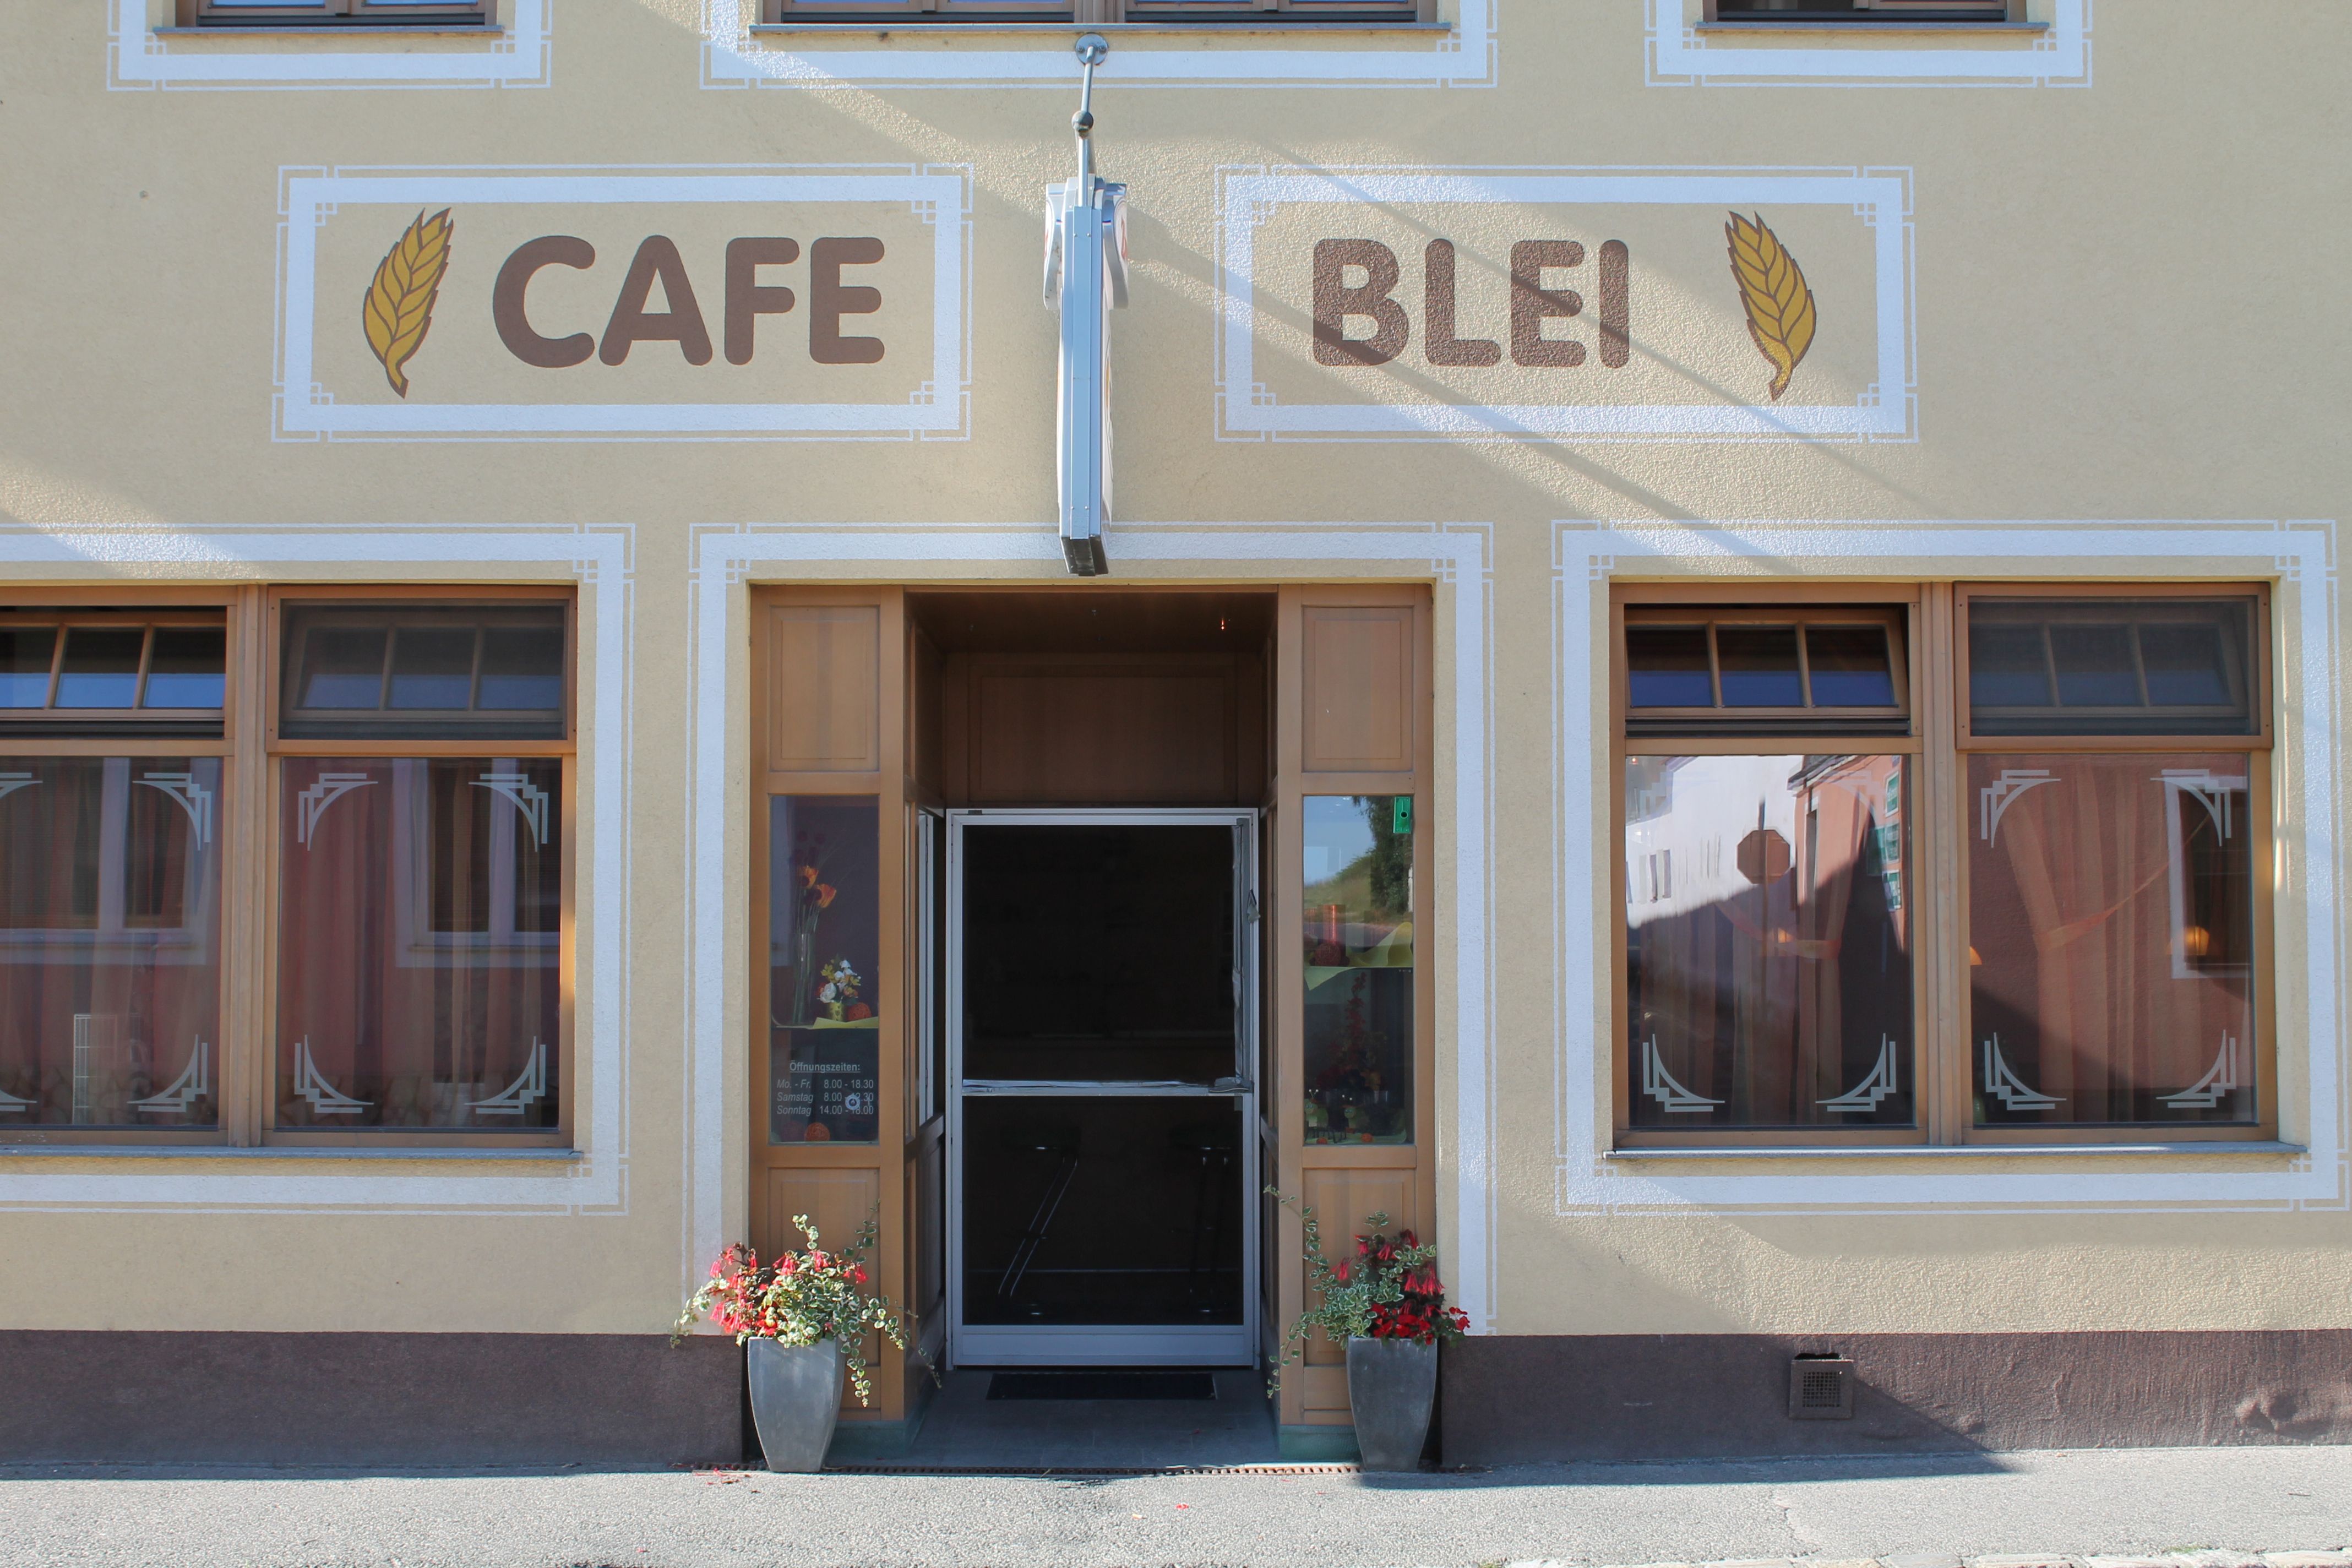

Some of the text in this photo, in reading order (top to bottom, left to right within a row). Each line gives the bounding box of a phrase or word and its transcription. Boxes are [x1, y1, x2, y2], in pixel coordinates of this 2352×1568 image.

[493, 235, 1629, 368] CAFE BLEI
[790, 1060, 861, 1073] Öffnungszeiten:
[777, 1079, 792, 1088] Mo.
[801, 1079, 811, 1088] Fr.
[824, 1079, 842, 1088] 8.00
[851, 1079, 874, 1088] 18.30
[777, 1092, 814, 1104] Samstag
[824, 1092, 842, 1102] 8.00
[777, 1105, 812, 1117] Sonntag
[820, 1105, 842, 1115] 14.00
